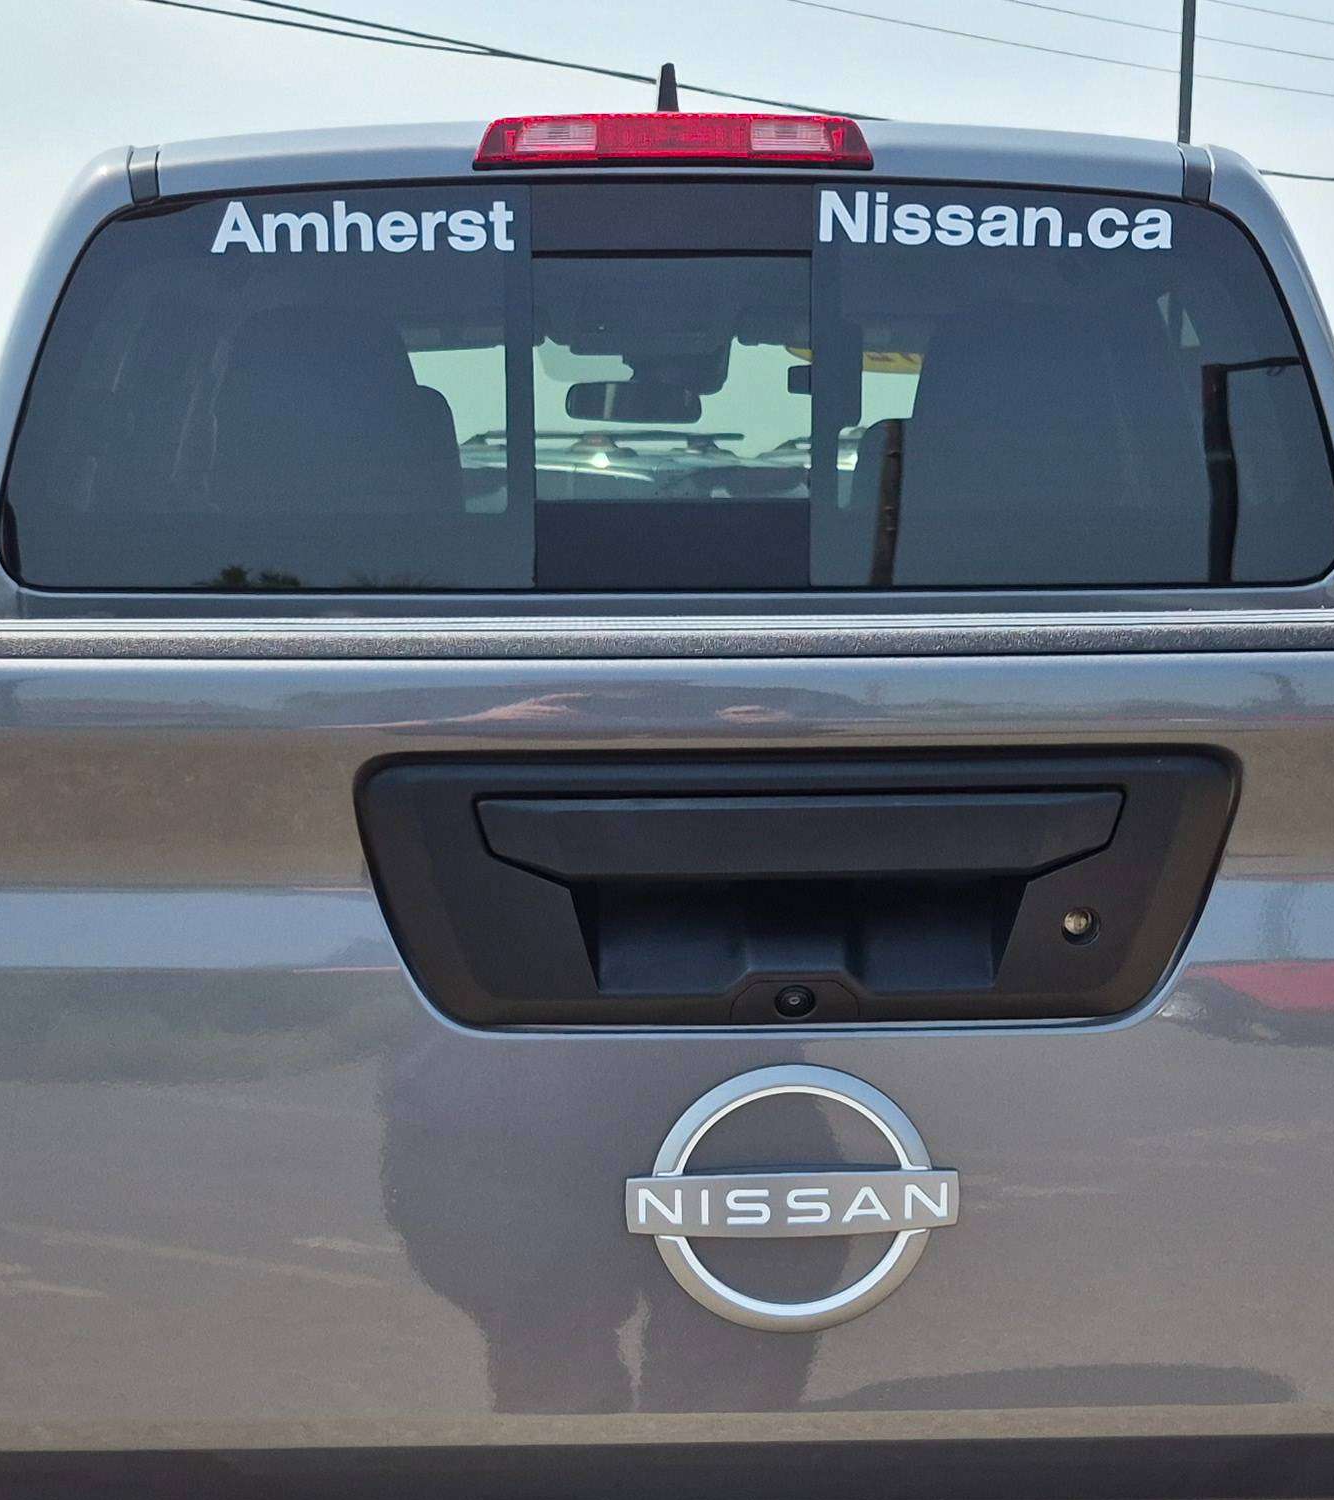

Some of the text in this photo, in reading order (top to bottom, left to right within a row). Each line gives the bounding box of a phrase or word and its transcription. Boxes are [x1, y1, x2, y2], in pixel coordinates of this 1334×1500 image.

[211, 190, 1173, 253] Amherst Nissan.ca
[637, 1182, 948, 1226] NISSAN
